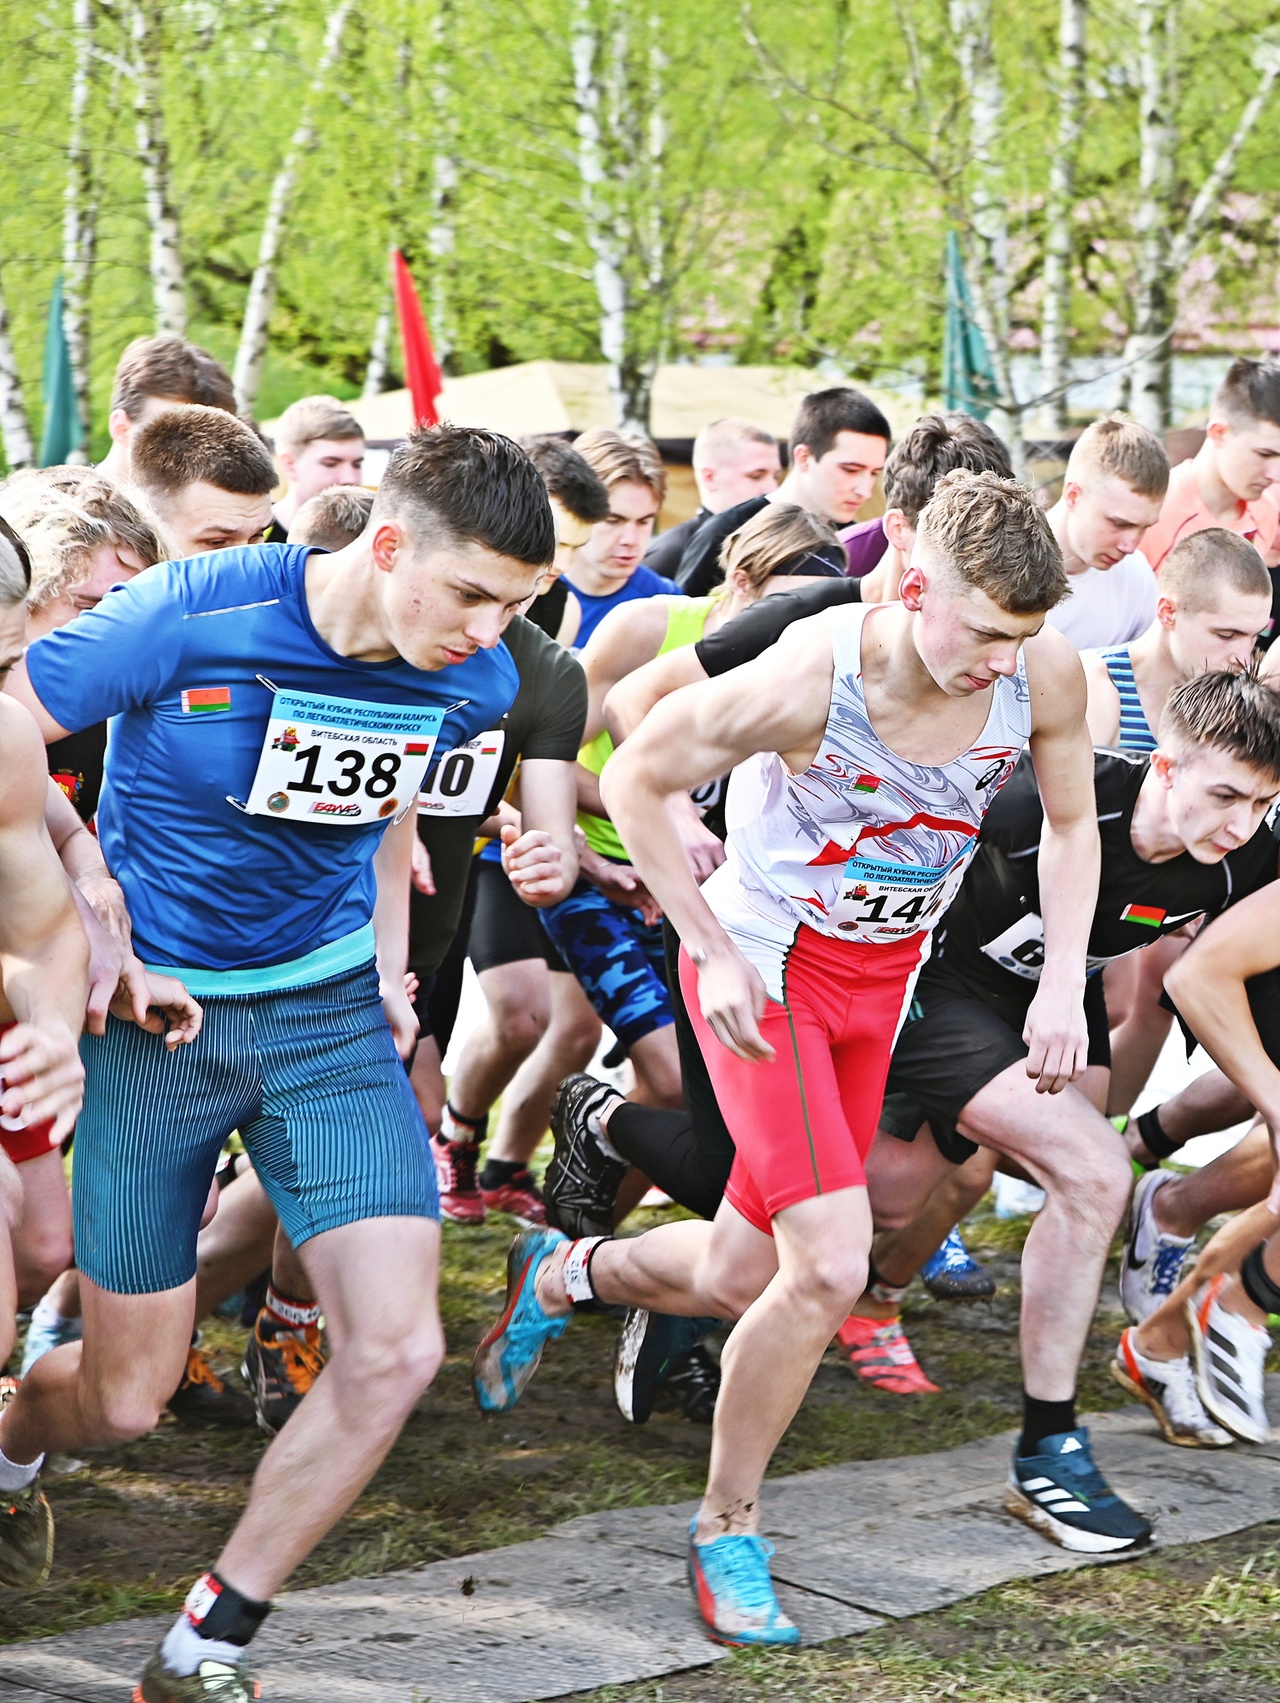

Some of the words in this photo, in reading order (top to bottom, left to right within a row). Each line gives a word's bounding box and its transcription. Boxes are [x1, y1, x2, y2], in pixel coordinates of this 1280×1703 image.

[280, 697, 325, 711] ОТКРЫТЫЙ
[327, 704, 351, 714] КУБОК
[354, 708, 401, 719] РЕСПУБЛИКИ
[401, 713, 438, 722] БЕЛАРУСЬ
[292, 709, 305, 718] ПО
[306, 711, 393, 731] ЛЕГКОАТЛЕТИЧЕСКОМУ
[393, 722, 422, 732] КРОССУ
[311, 729, 359, 743] ВИТЕБСКАЯ
[361, 736, 398, 746] ОБЛАСТЬ
[286, 744, 401, 799] 138
[852, 861, 893, 874] ОТКРЫТЫЙ
[893, 867, 917, 877] КУБОК
[878, 885, 923, 893] ВИТЕБСКАЯ
